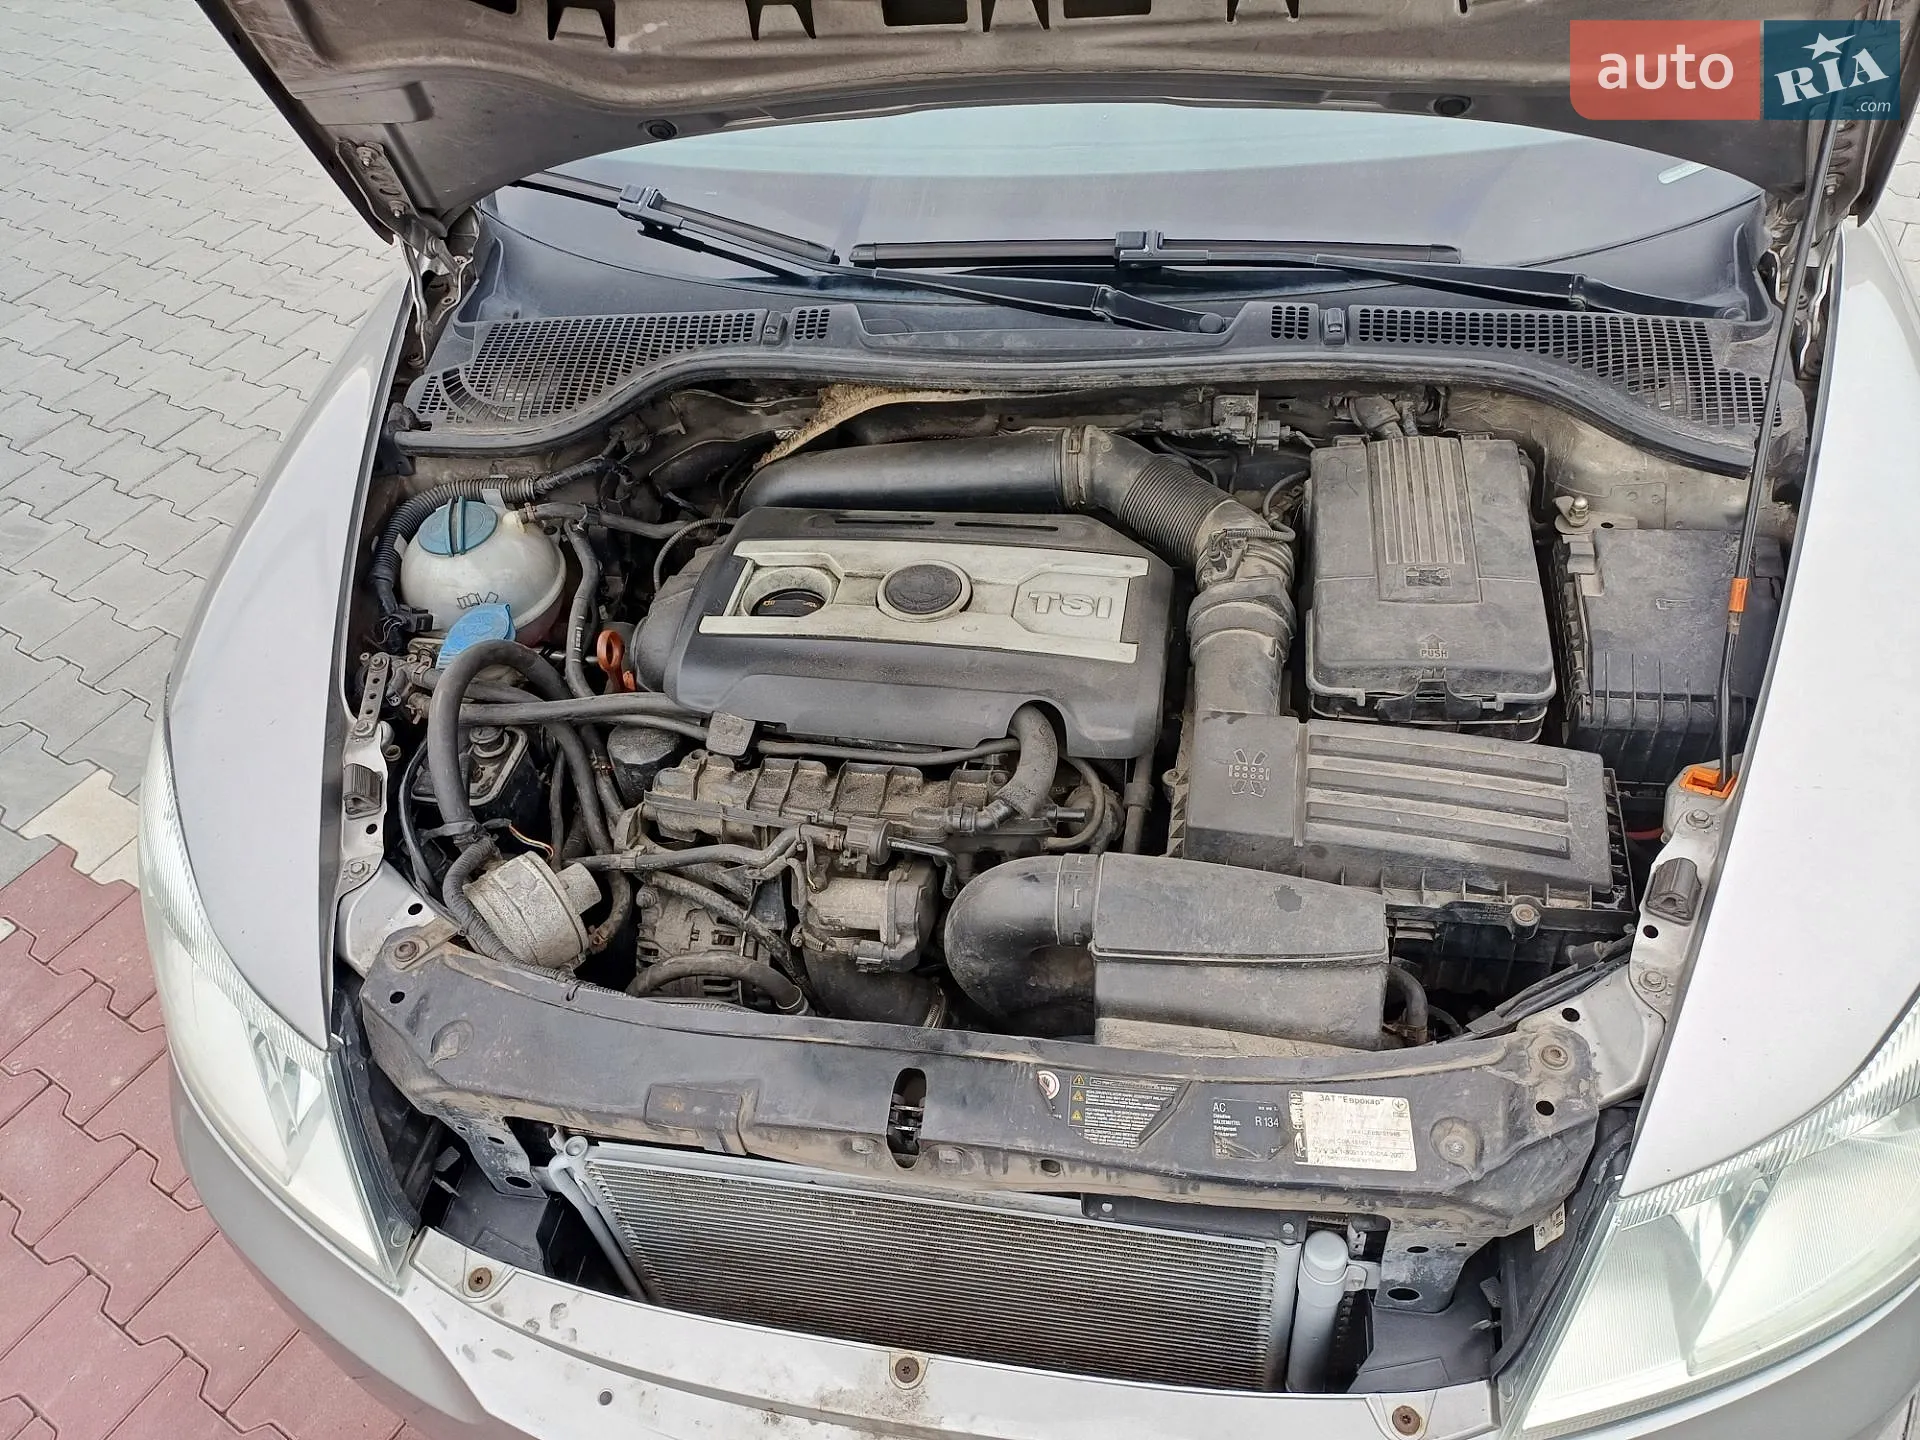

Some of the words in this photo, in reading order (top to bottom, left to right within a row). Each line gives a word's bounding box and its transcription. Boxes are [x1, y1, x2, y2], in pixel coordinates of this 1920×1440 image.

[1027, 591, 1112, 619] TSI
[1420, 649, 1449, 659] PUSH
[1212, 1102, 1226, 1113] AC
[1254, 1115, 1263, 1127] R
[1263, 1116, 1280, 1129] 134
